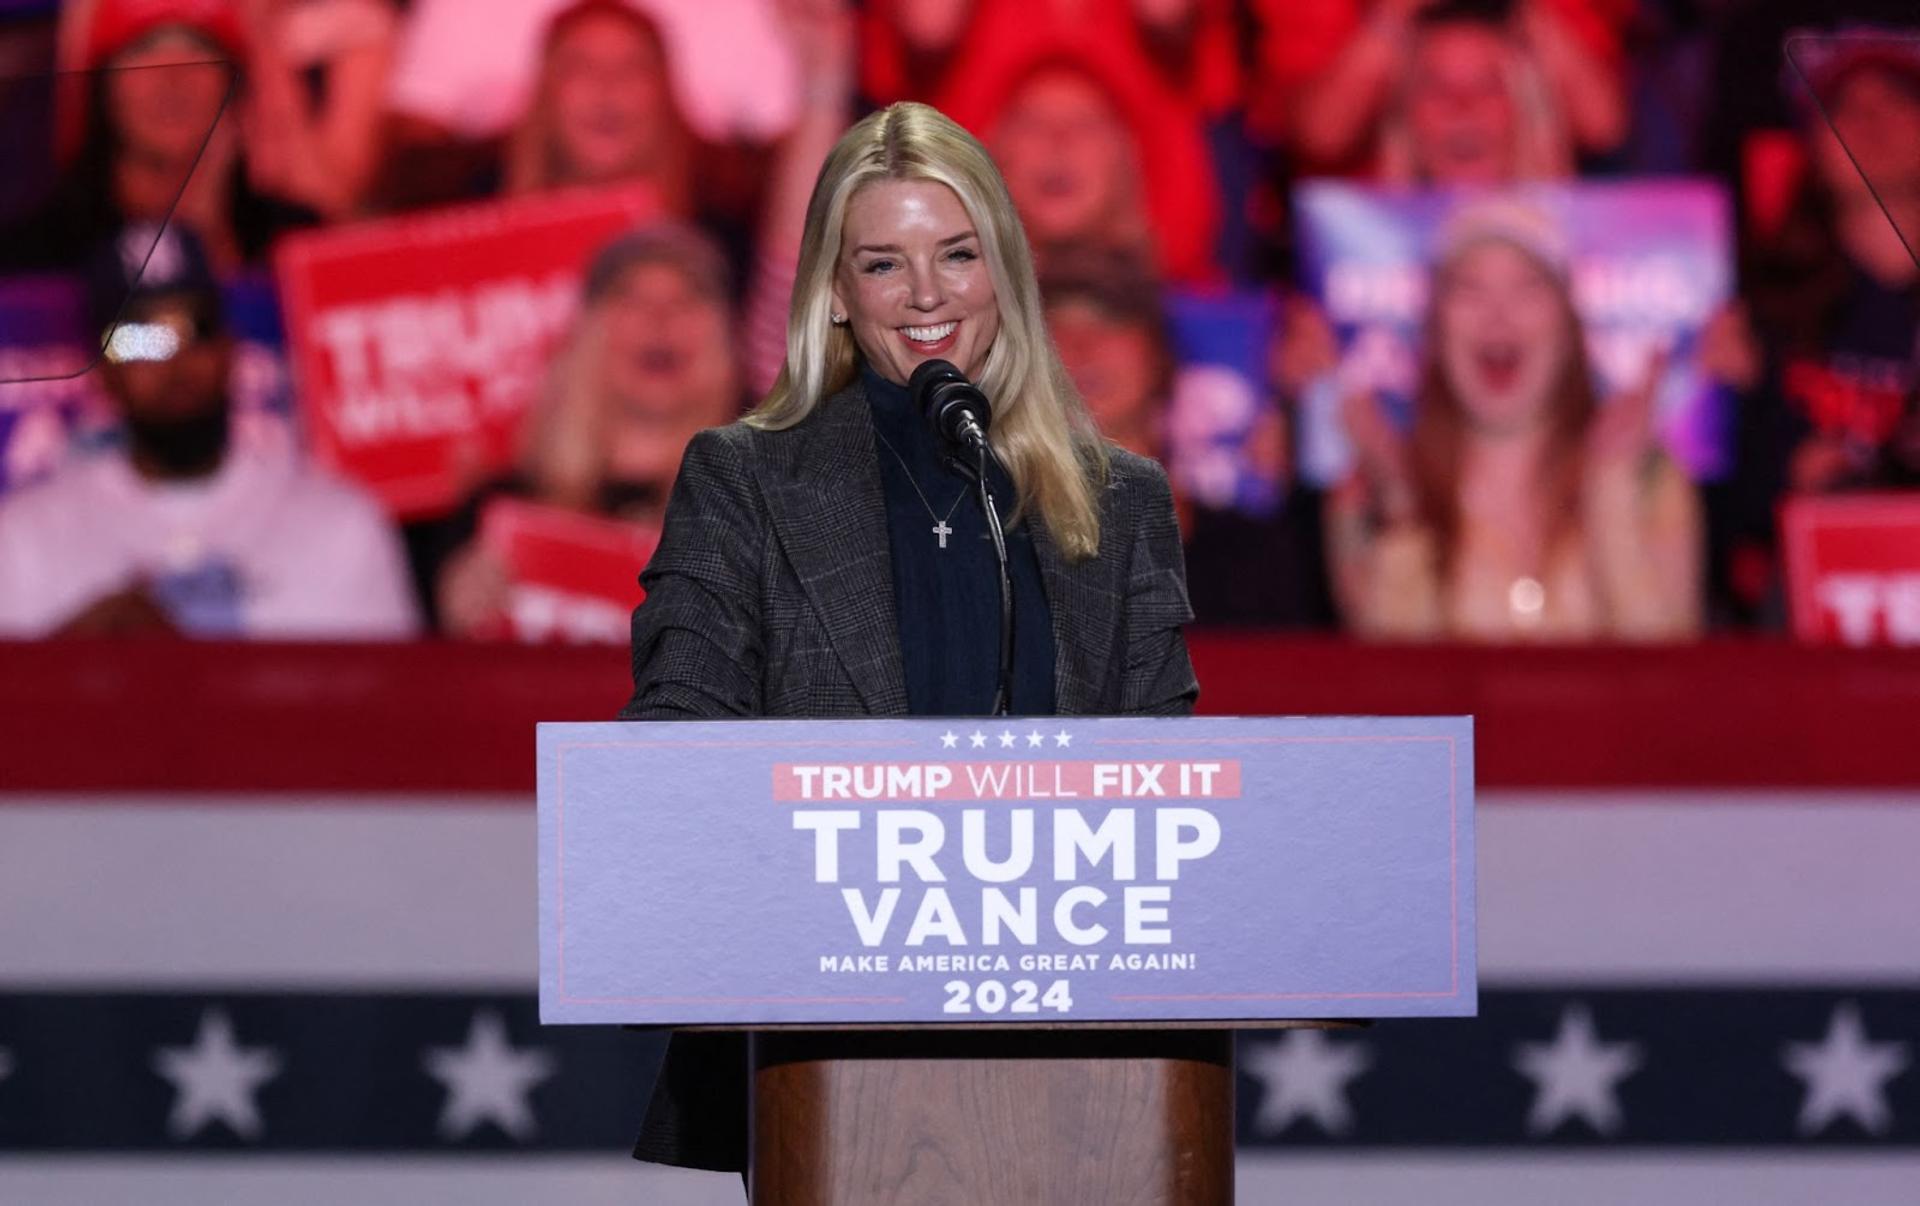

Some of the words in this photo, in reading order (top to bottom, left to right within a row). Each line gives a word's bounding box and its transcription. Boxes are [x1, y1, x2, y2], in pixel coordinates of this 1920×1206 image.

[793, 765, 953, 799] TRUMP
[965, 764, 1079, 798] WILL
[1093, 763, 1166, 797] FIX
[1179, 763, 1221, 796] IT
[792, 807, 1222, 884] TRUMP
[840, 885, 1173, 947] VANCE
[820, 955, 889, 973] MAKE
[898, 955, 1010, 972] AMERICA
[1019, 954, 1100, 972] GREAT
[1109, 953, 1195, 971] AGAIN!
[943, 979, 1073, 1015] 2024
